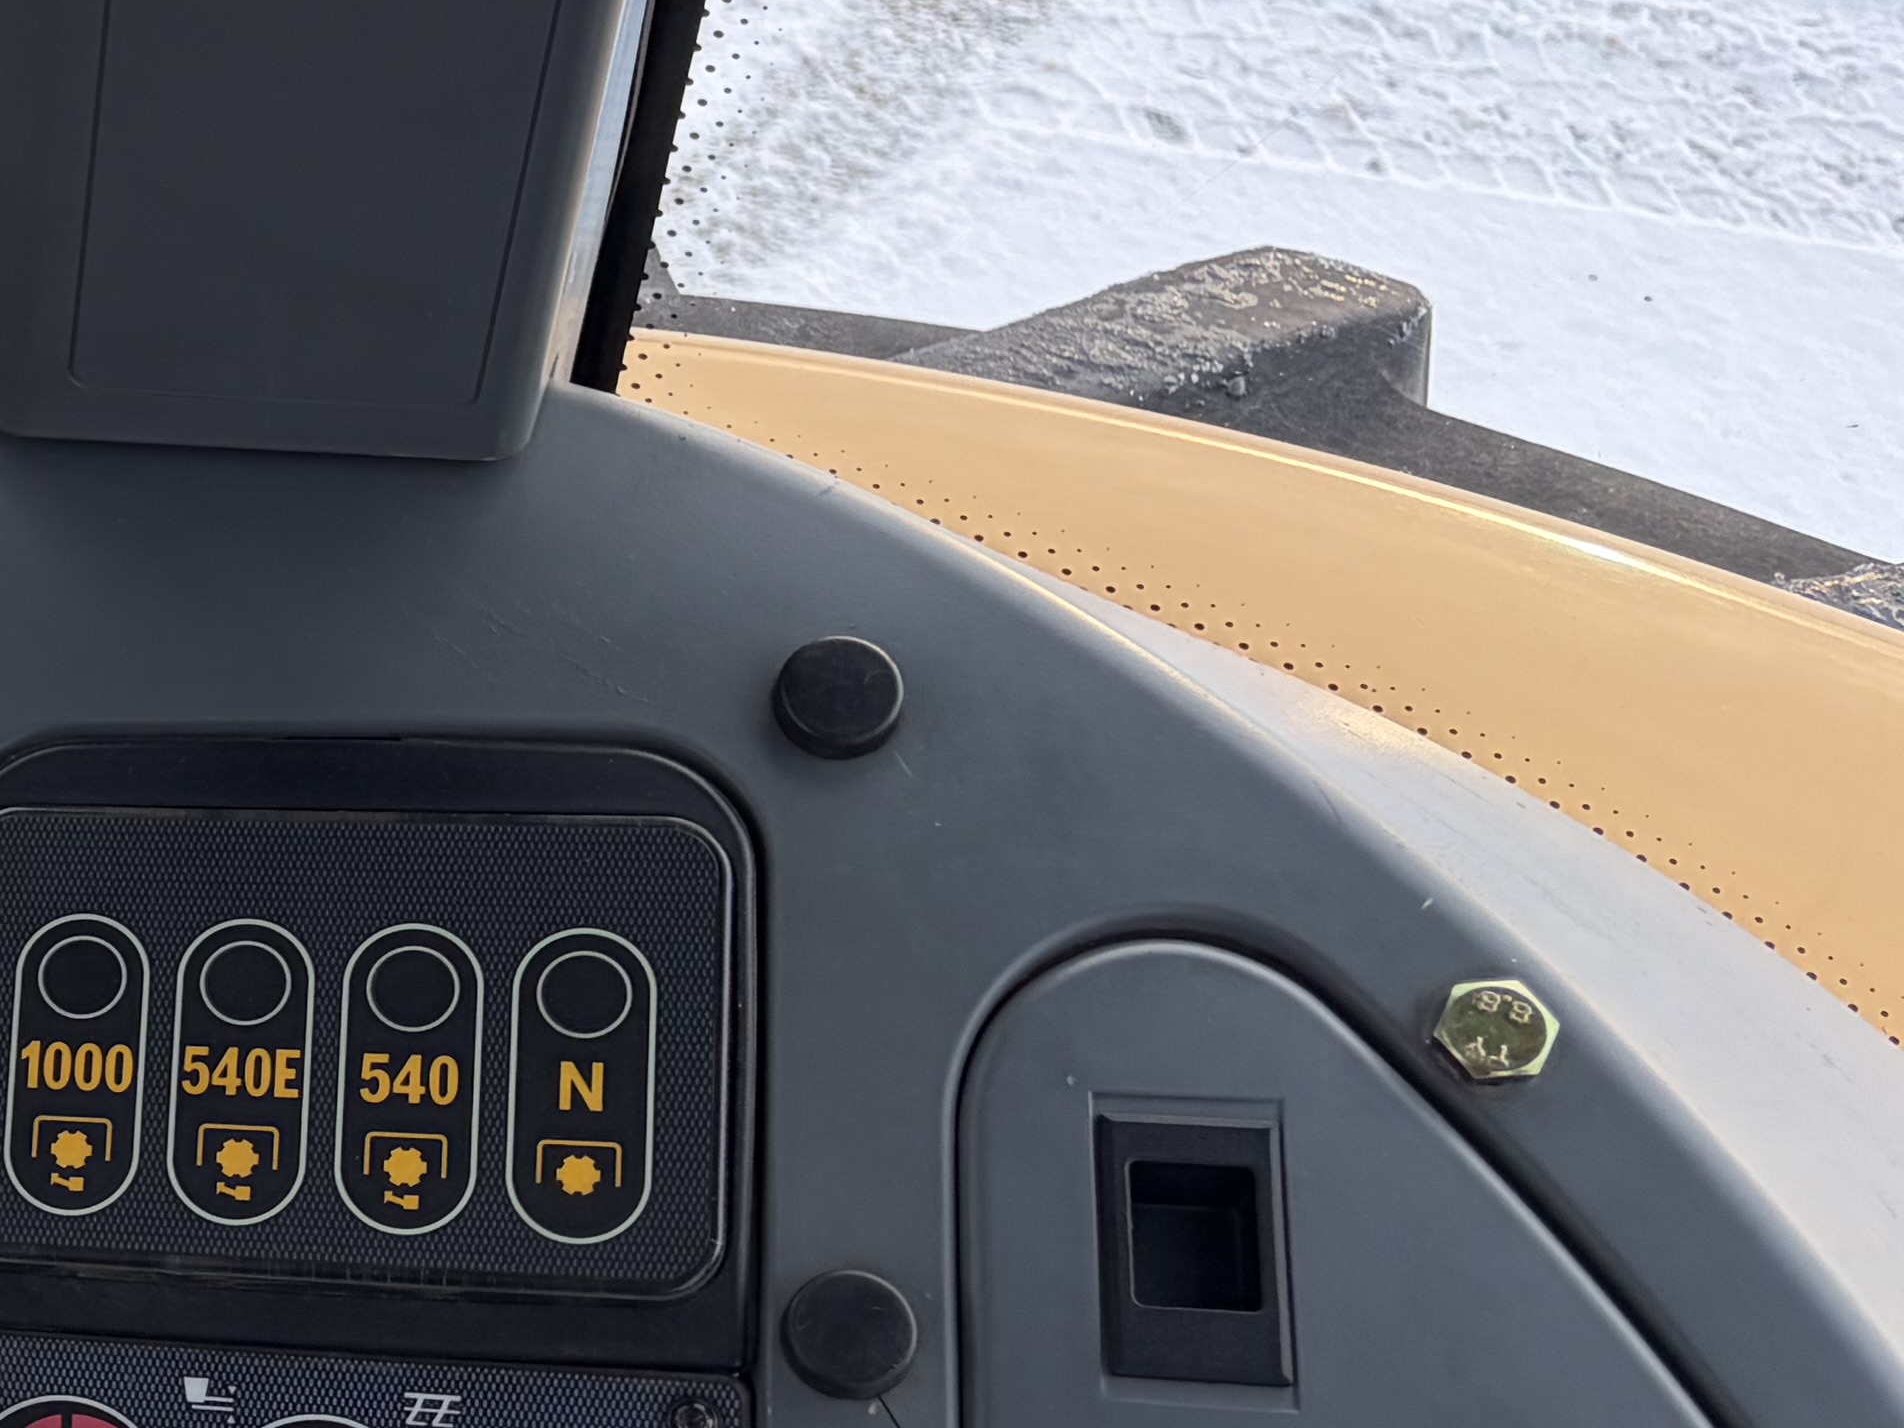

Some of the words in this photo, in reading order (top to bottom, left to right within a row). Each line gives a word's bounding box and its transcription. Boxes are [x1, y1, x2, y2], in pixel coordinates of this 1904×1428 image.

[20, 1040, 134, 1094] 1000
[182, 1046, 301, 1099] 540E
[359, 1053, 460, 1107] 540
[558, 1060, 605, 1112] N
